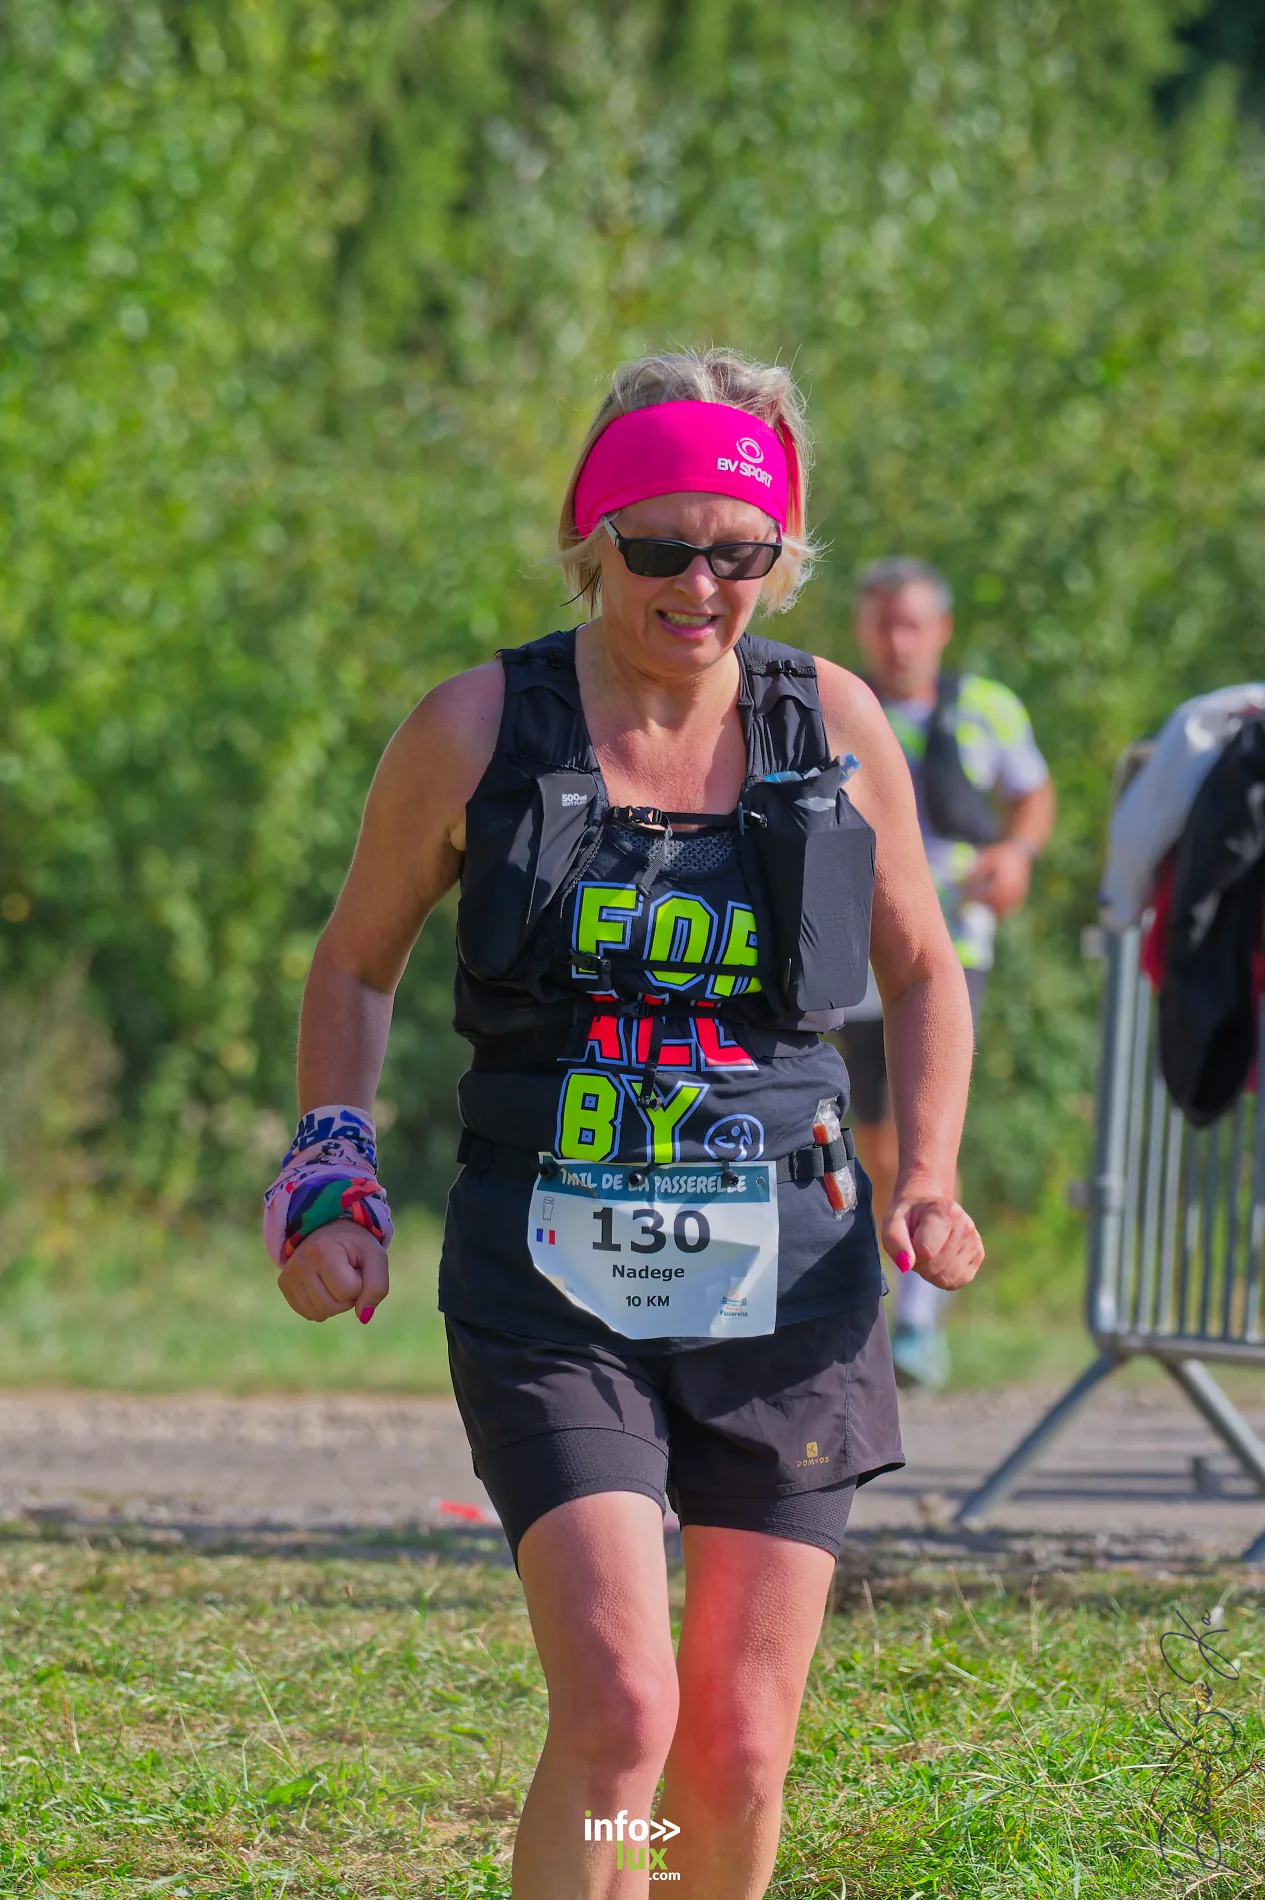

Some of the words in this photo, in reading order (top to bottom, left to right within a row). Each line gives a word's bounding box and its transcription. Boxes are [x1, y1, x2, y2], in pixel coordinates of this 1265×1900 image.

[717, 457, 739, 472] BV
[739, 462, 773, 488] SPORT
[554, 1068, 710, 1164] BY
[602, 1173, 624, 1190] DE
[592, 1207, 711, 1254] 130
[612, 1264, 686, 1282] Nadege
[625, 1295, 642, 1307] 10
[646, 1295, 670, 1307] KM
[796, 1456, 830, 1468] DOMYOS
